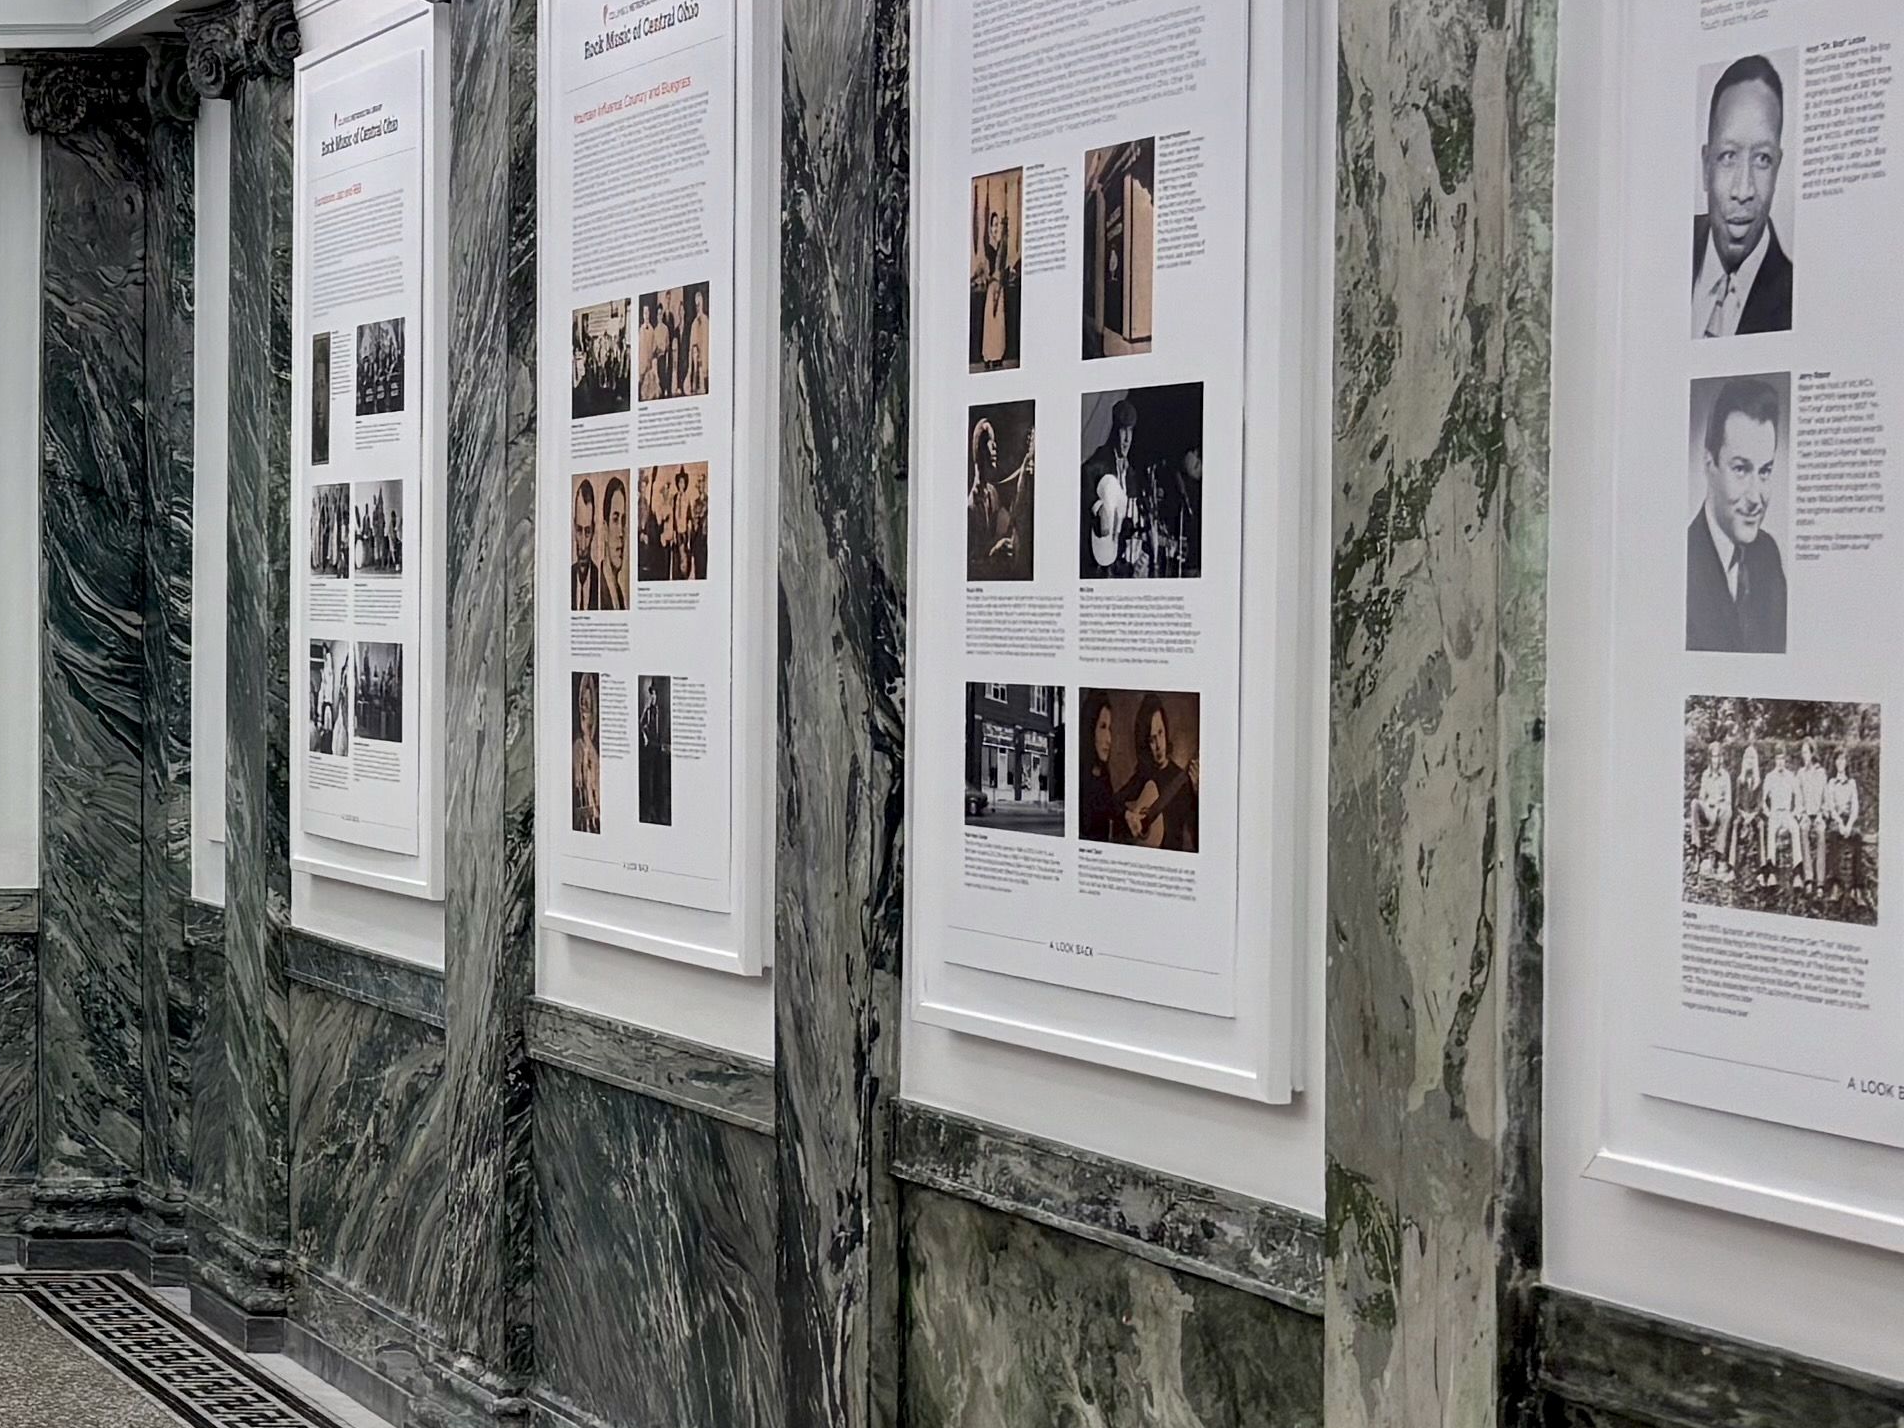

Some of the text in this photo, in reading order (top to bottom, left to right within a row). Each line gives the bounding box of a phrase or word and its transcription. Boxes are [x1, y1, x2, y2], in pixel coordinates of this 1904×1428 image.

[584, 35, 604, 60] Rock
[606, 25, 631, 51] Music
[633, 19, 641, 40] of
[643, 6, 675, 36] Central
[677, 0, 699, 23] Ohio
[1847, 1077, 1894, 1098] A LOOK
